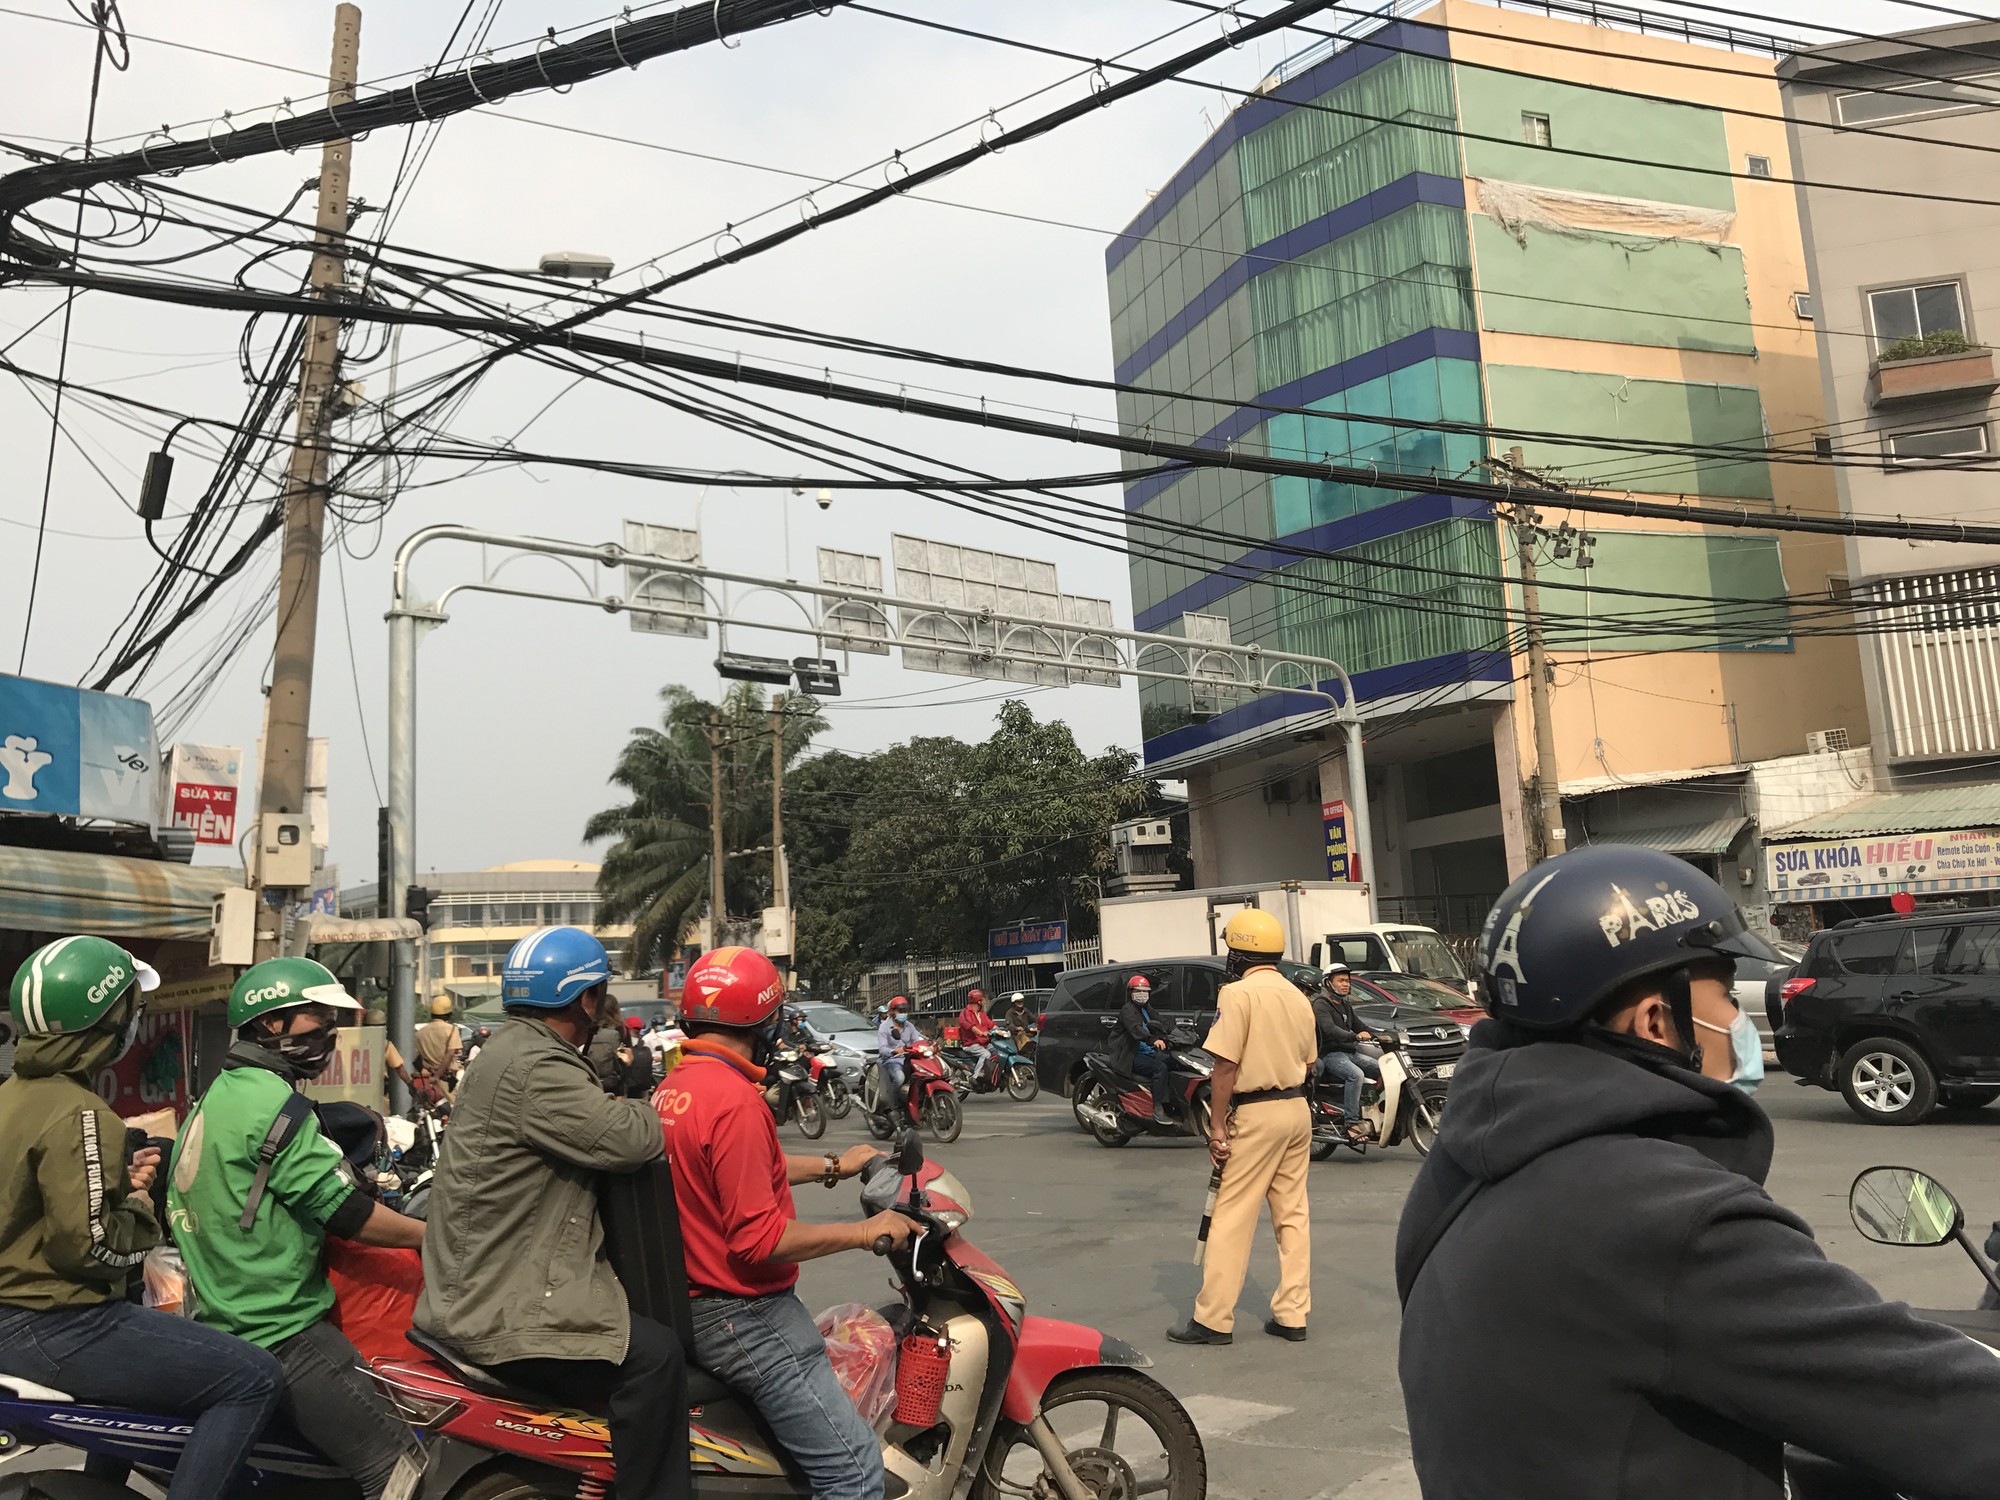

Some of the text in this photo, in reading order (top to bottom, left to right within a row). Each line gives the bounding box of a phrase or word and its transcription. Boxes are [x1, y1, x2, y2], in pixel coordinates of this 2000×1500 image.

[180, 786, 232, 801] SỬA XE
[1329, 804, 1343, 815] OFFICE
[1328, 825, 1342, 840] VĂN
[1326, 841, 1347, 856] PHÒNG
[1776, 835, 1933, 872] SỬA KHÓA HIẾU
[1937, 846, 1960, 856] Remote
[1332, 860, 1345, 872] CHO
[1967, 857, 1976, 868] Xe
[1599, 883, 1699, 948] PARIS
[1009, 931, 1019, 945] XE
[1231, 931, 1257, 944] CSGT
[87, 965, 125, 1003] Grab
[244, 981, 290, 1005] Grab
[50, 1413, 166, 1432] EXCITER
[494, 1418, 565, 1441] wave
